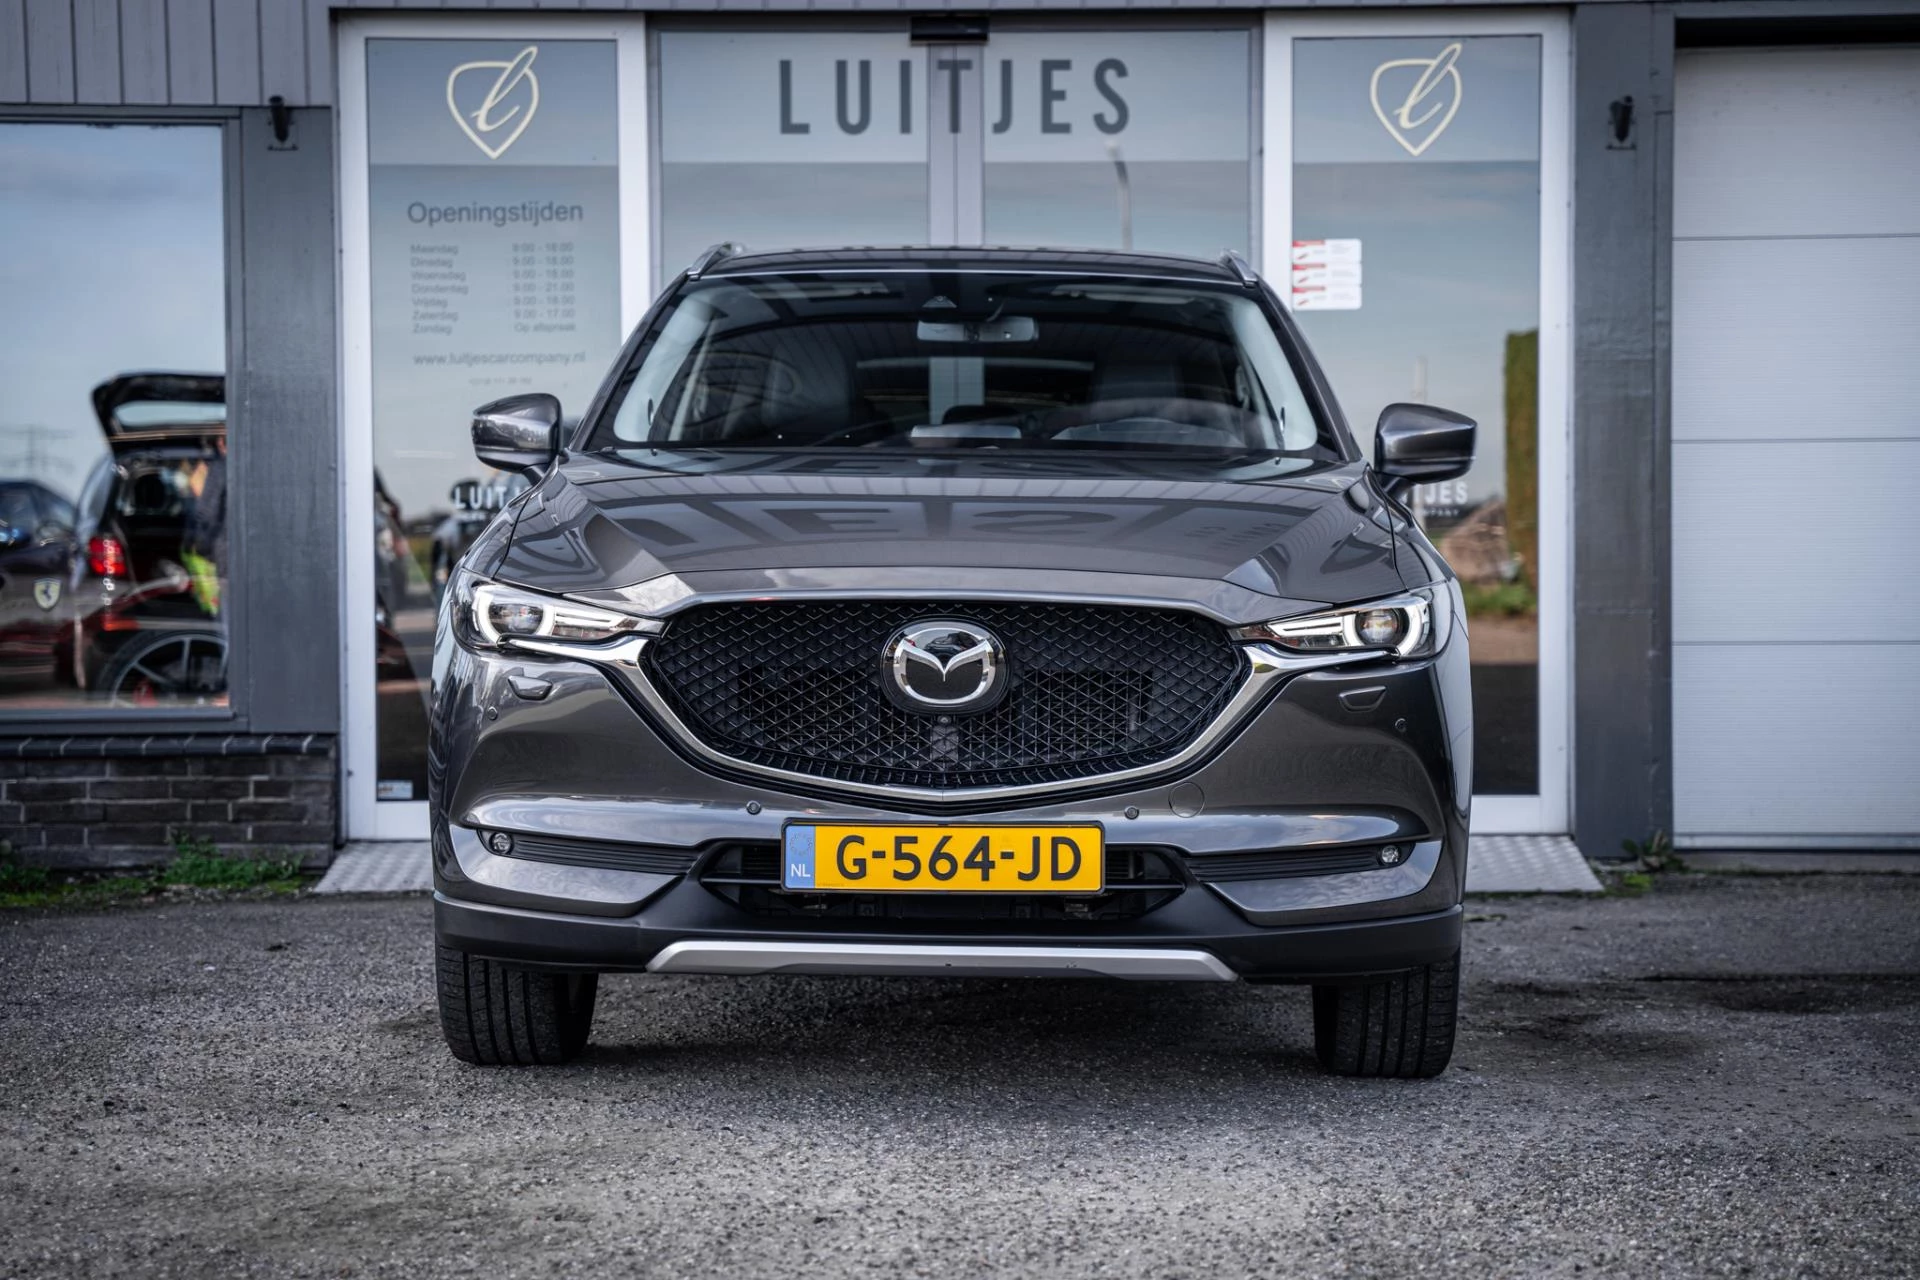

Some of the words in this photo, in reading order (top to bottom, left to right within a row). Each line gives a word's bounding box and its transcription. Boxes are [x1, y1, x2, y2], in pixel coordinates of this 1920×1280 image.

[779, 57, 1130, 135] LUITJES
[407, 201, 584, 228] Openingstijden
[410, 257, 454, 269] Dinsdag
[411, 270, 467, 283] Woensdag
[411, 283, 469, 296] Donderdag
[412, 310, 459, 323] Zaterdag
[412, 323, 453, 336] Zondag
[513, 322, 530, 334] Op
[413, 351, 586, 367] www.luitjescarcompany.nl
[455, 485, 531, 509] LUIT
[836, 834, 1082, 882] G-564-JD
[790, 863, 811, 878] NL
